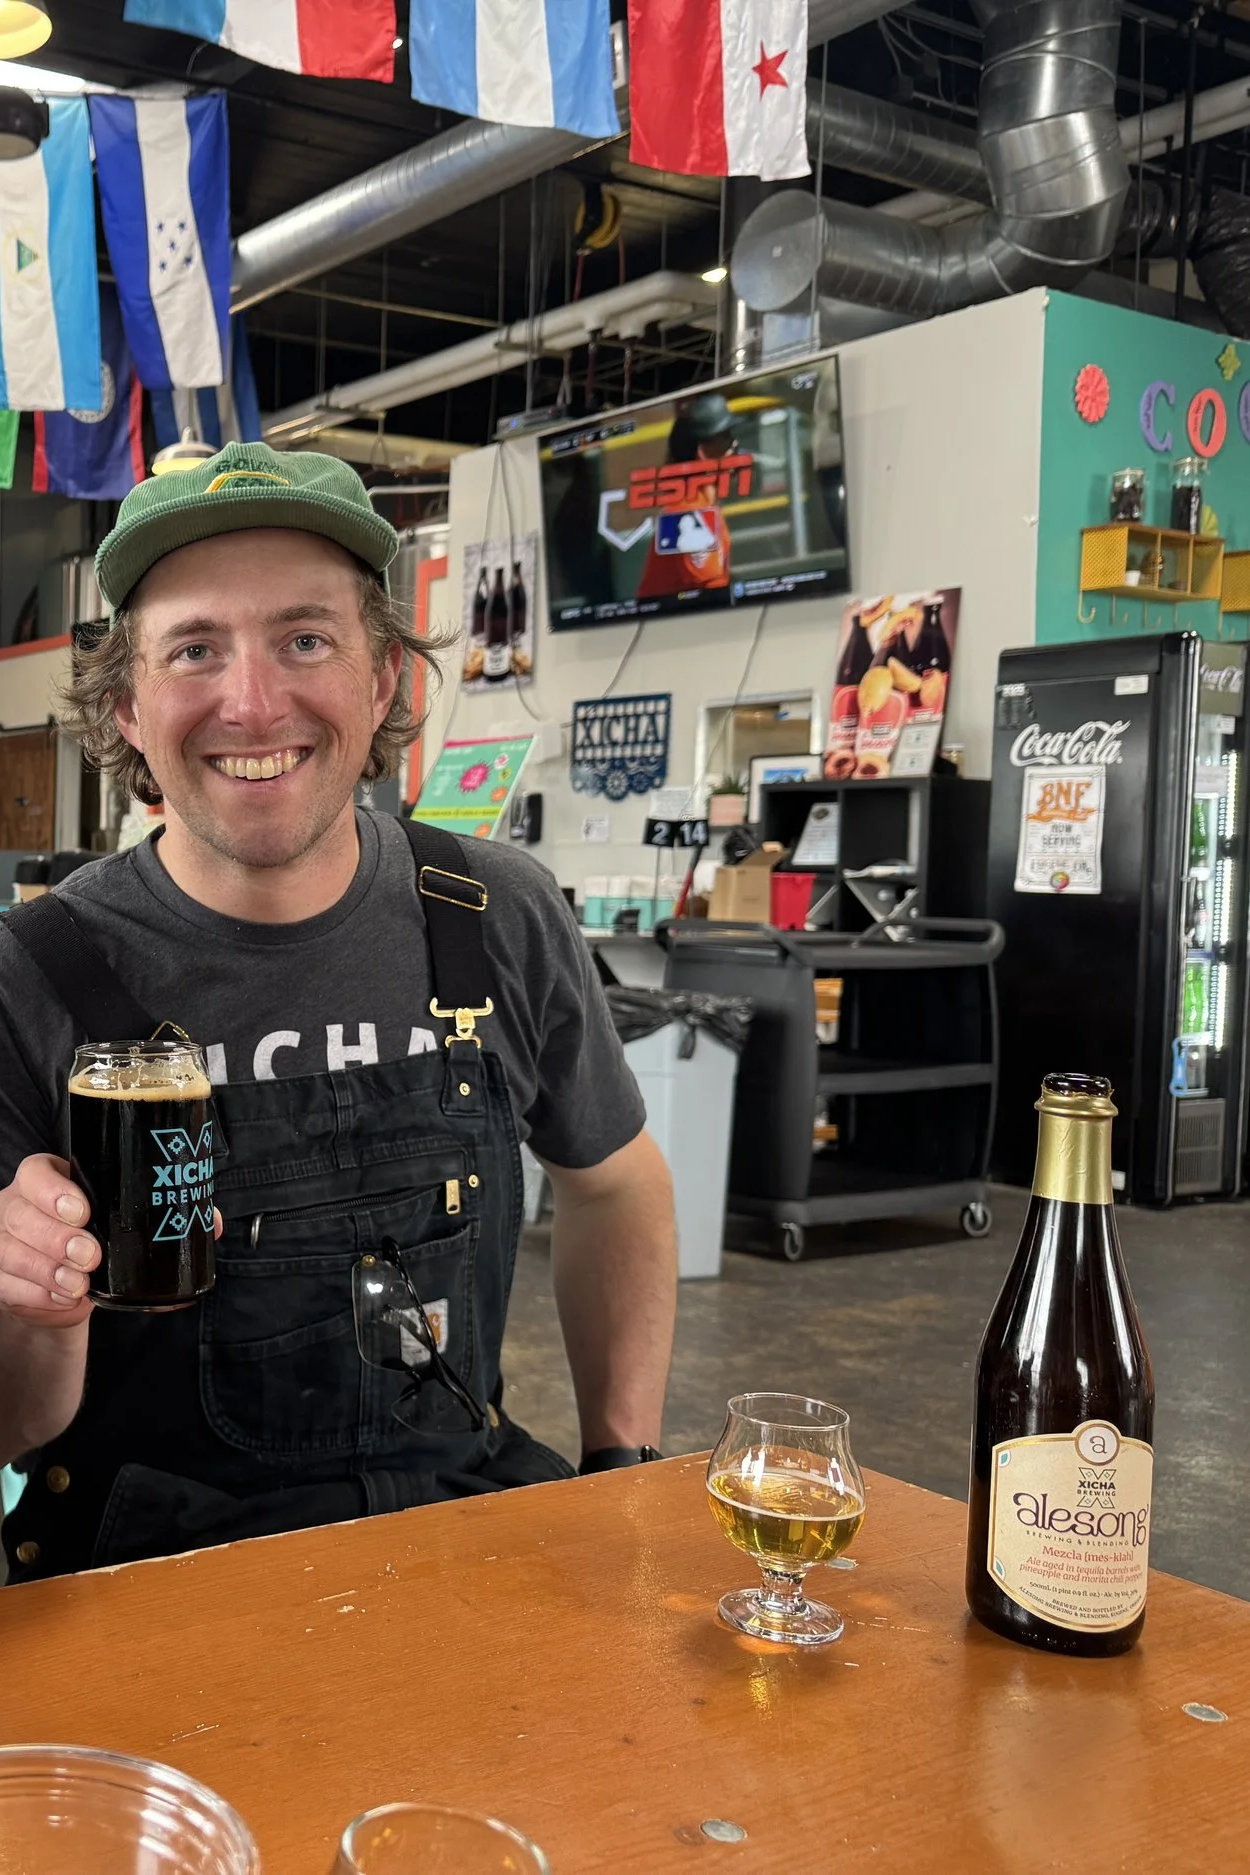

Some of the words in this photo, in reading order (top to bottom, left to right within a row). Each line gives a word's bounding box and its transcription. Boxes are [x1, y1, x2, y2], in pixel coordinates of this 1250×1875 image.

[629, 453, 753, 509] ESPN
[577, 713, 661, 747] XICHA
[651, 821, 670, 845] 2
[680, 820, 706, 845] 14
[206, 1022, 438, 1084] ICHA
[152, 1180, 214, 1206] BREWIN
[1090, 1435, 1107, 1454] a
[1077, 1489, 1116, 1497] BREWING
[1078, 1480, 1116, 1490] XICHA
[1013, 1492, 1149, 1547] alesong
[1026, 1530, 1072, 1543] BREWING
[1043, 1546, 1082, 1561] Mezcla
[1020, 1563, 1061, 1579] pineapple
[1063, 1573, 1080, 1582] and
[1081, 1575, 1109, 1584] morita
[1026, 1556, 1041, 1566] Ale
[1042, 1561, 1064, 1571] aged
[1066, 1563, 1075, 1572] in
[1076, 1566, 1104, 1575] tequila
[1019, 1586, 1044, 1604] ALESONG
[1045, 1602, 1072, 1615] BREWING
[1052, 1599, 1077, 1610] BREWED
[1093, 1605, 1116, 1613] BOTTLED
